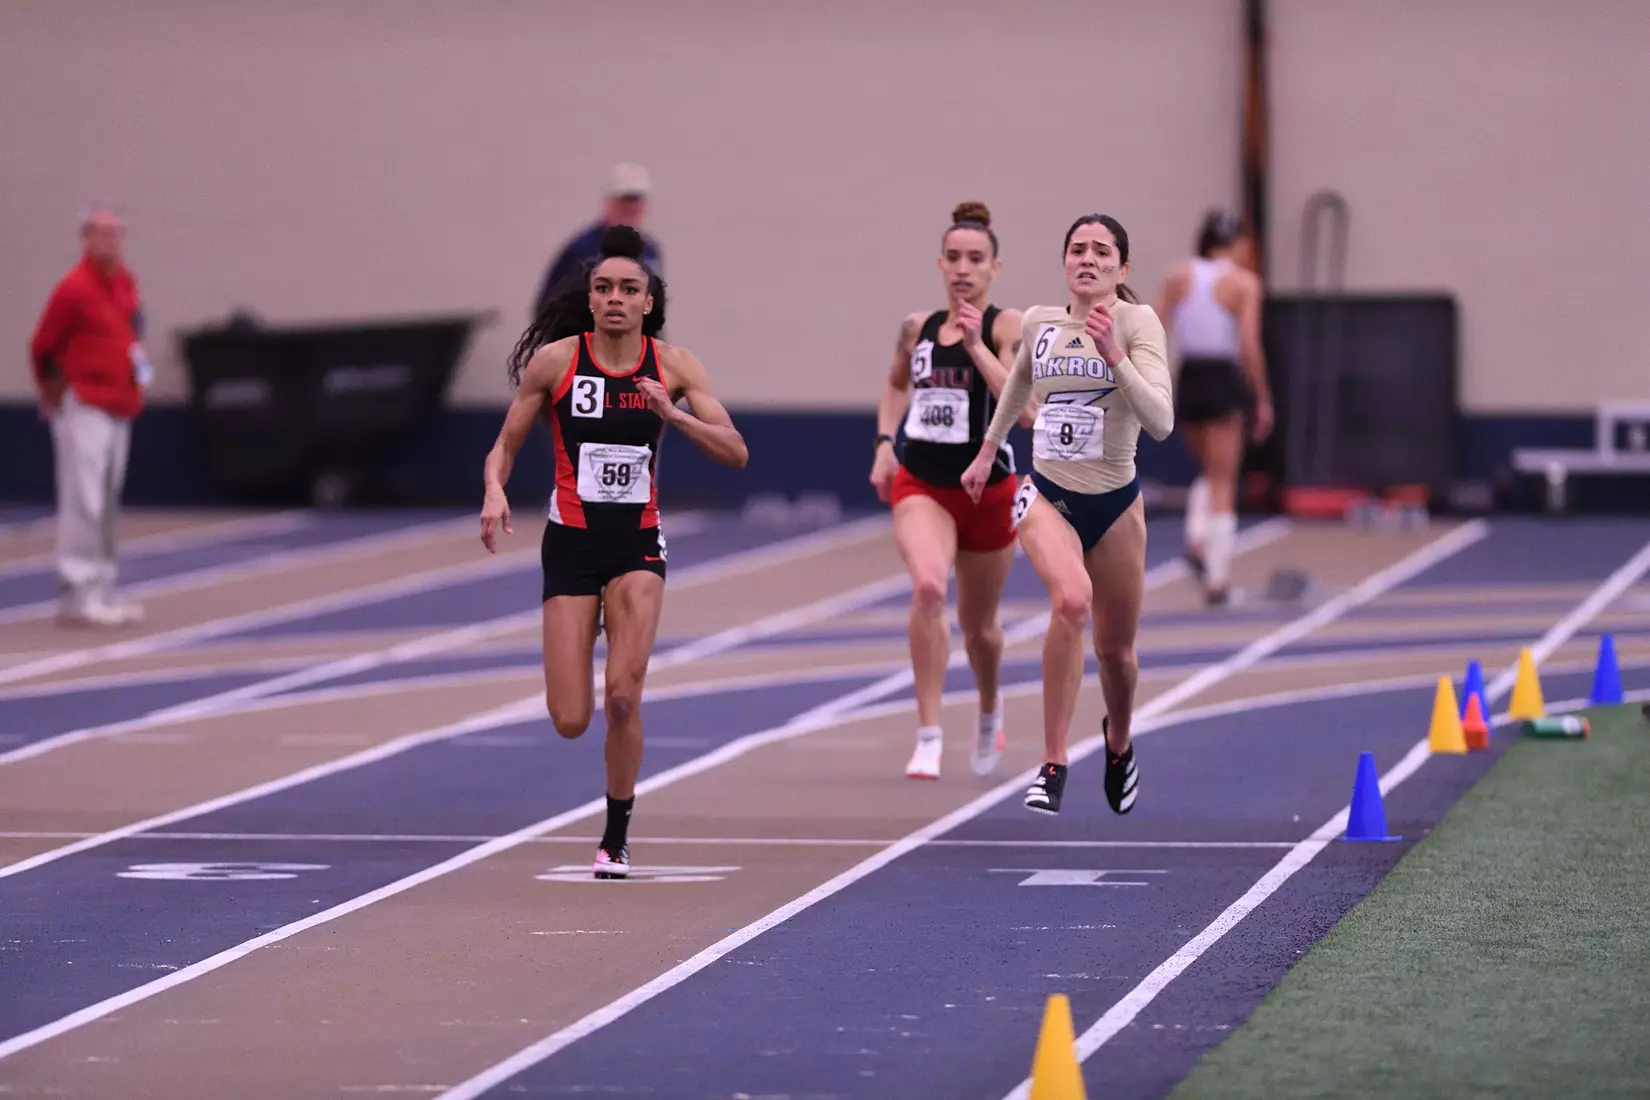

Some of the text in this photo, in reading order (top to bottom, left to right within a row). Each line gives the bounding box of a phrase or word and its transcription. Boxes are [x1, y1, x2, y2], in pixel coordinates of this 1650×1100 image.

[1035, 327, 1055, 359] 6
[914, 347, 928, 377] 5
[575, 379, 598, 414] 3
[920, 405, 954, 427] 408
[1061, 423, 1073, 445] 9
[602, 463, 631, 486] 59
